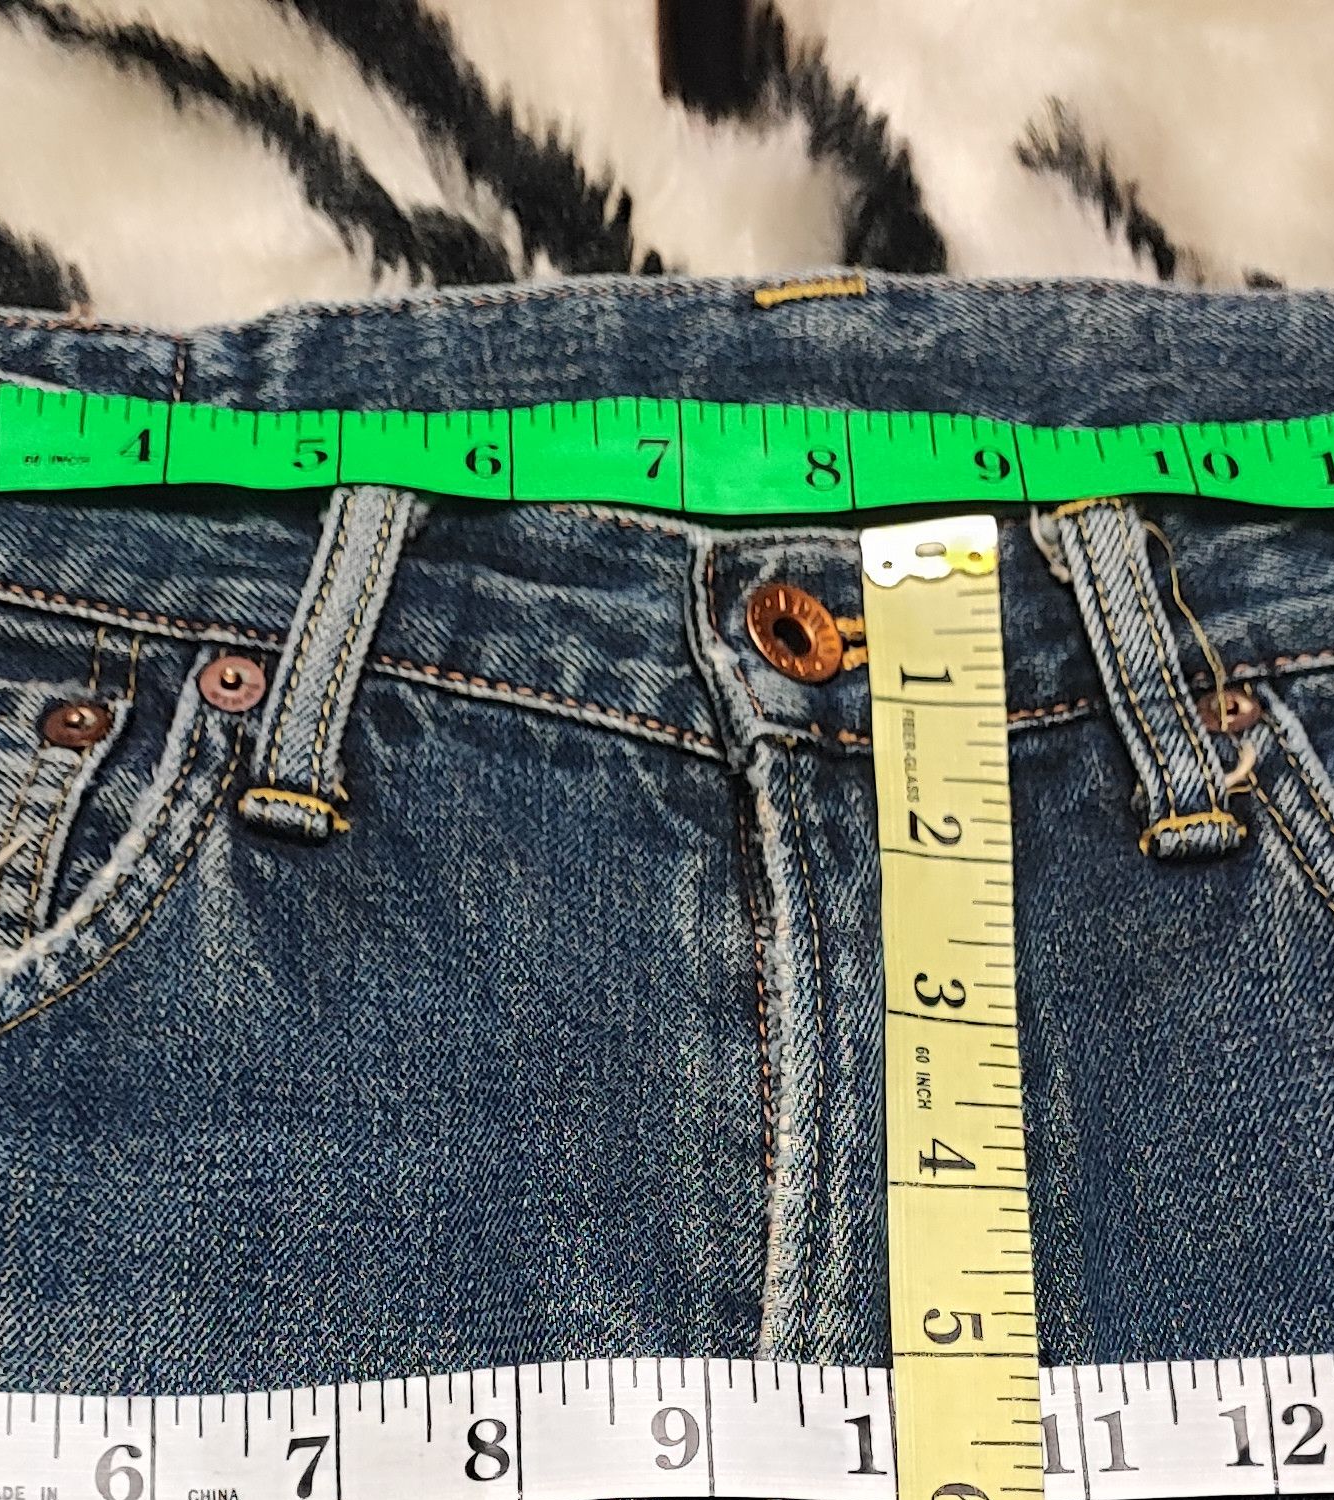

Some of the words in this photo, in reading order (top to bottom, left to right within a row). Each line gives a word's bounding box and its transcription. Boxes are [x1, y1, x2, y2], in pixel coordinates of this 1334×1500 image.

[118, 429, 152, 464] 4
[292, 438, 328, 472] 5
[466, 444, 502, 480] 6
[636, 437, 671, 480] 7
[804, 445, 842, 491] 8
[975, 448, 1010, 482] 9
[1149, 449, 1240, 483] 10
[899, 664, 954, 690] 1
[902, 708, 920, 803] FIBER-GLASS
[908, 810, 963, 847] 2
[914, 972, 967, 1008] 3
[915, 1046, 930, 1064] 60
[916, 1071, 933, 1111] INCH
[919, 1137, 976, 1178] 4
[923, 1308, 984, 1345] 5
[285, 1435, 331, 1499] 7
[464, 1417, 511, 1482] 8
[650, 1406, 700, 1470] 9
[844, 1413, 888, 1475] 1
[1218, 1401, 1328, 1467] 12
